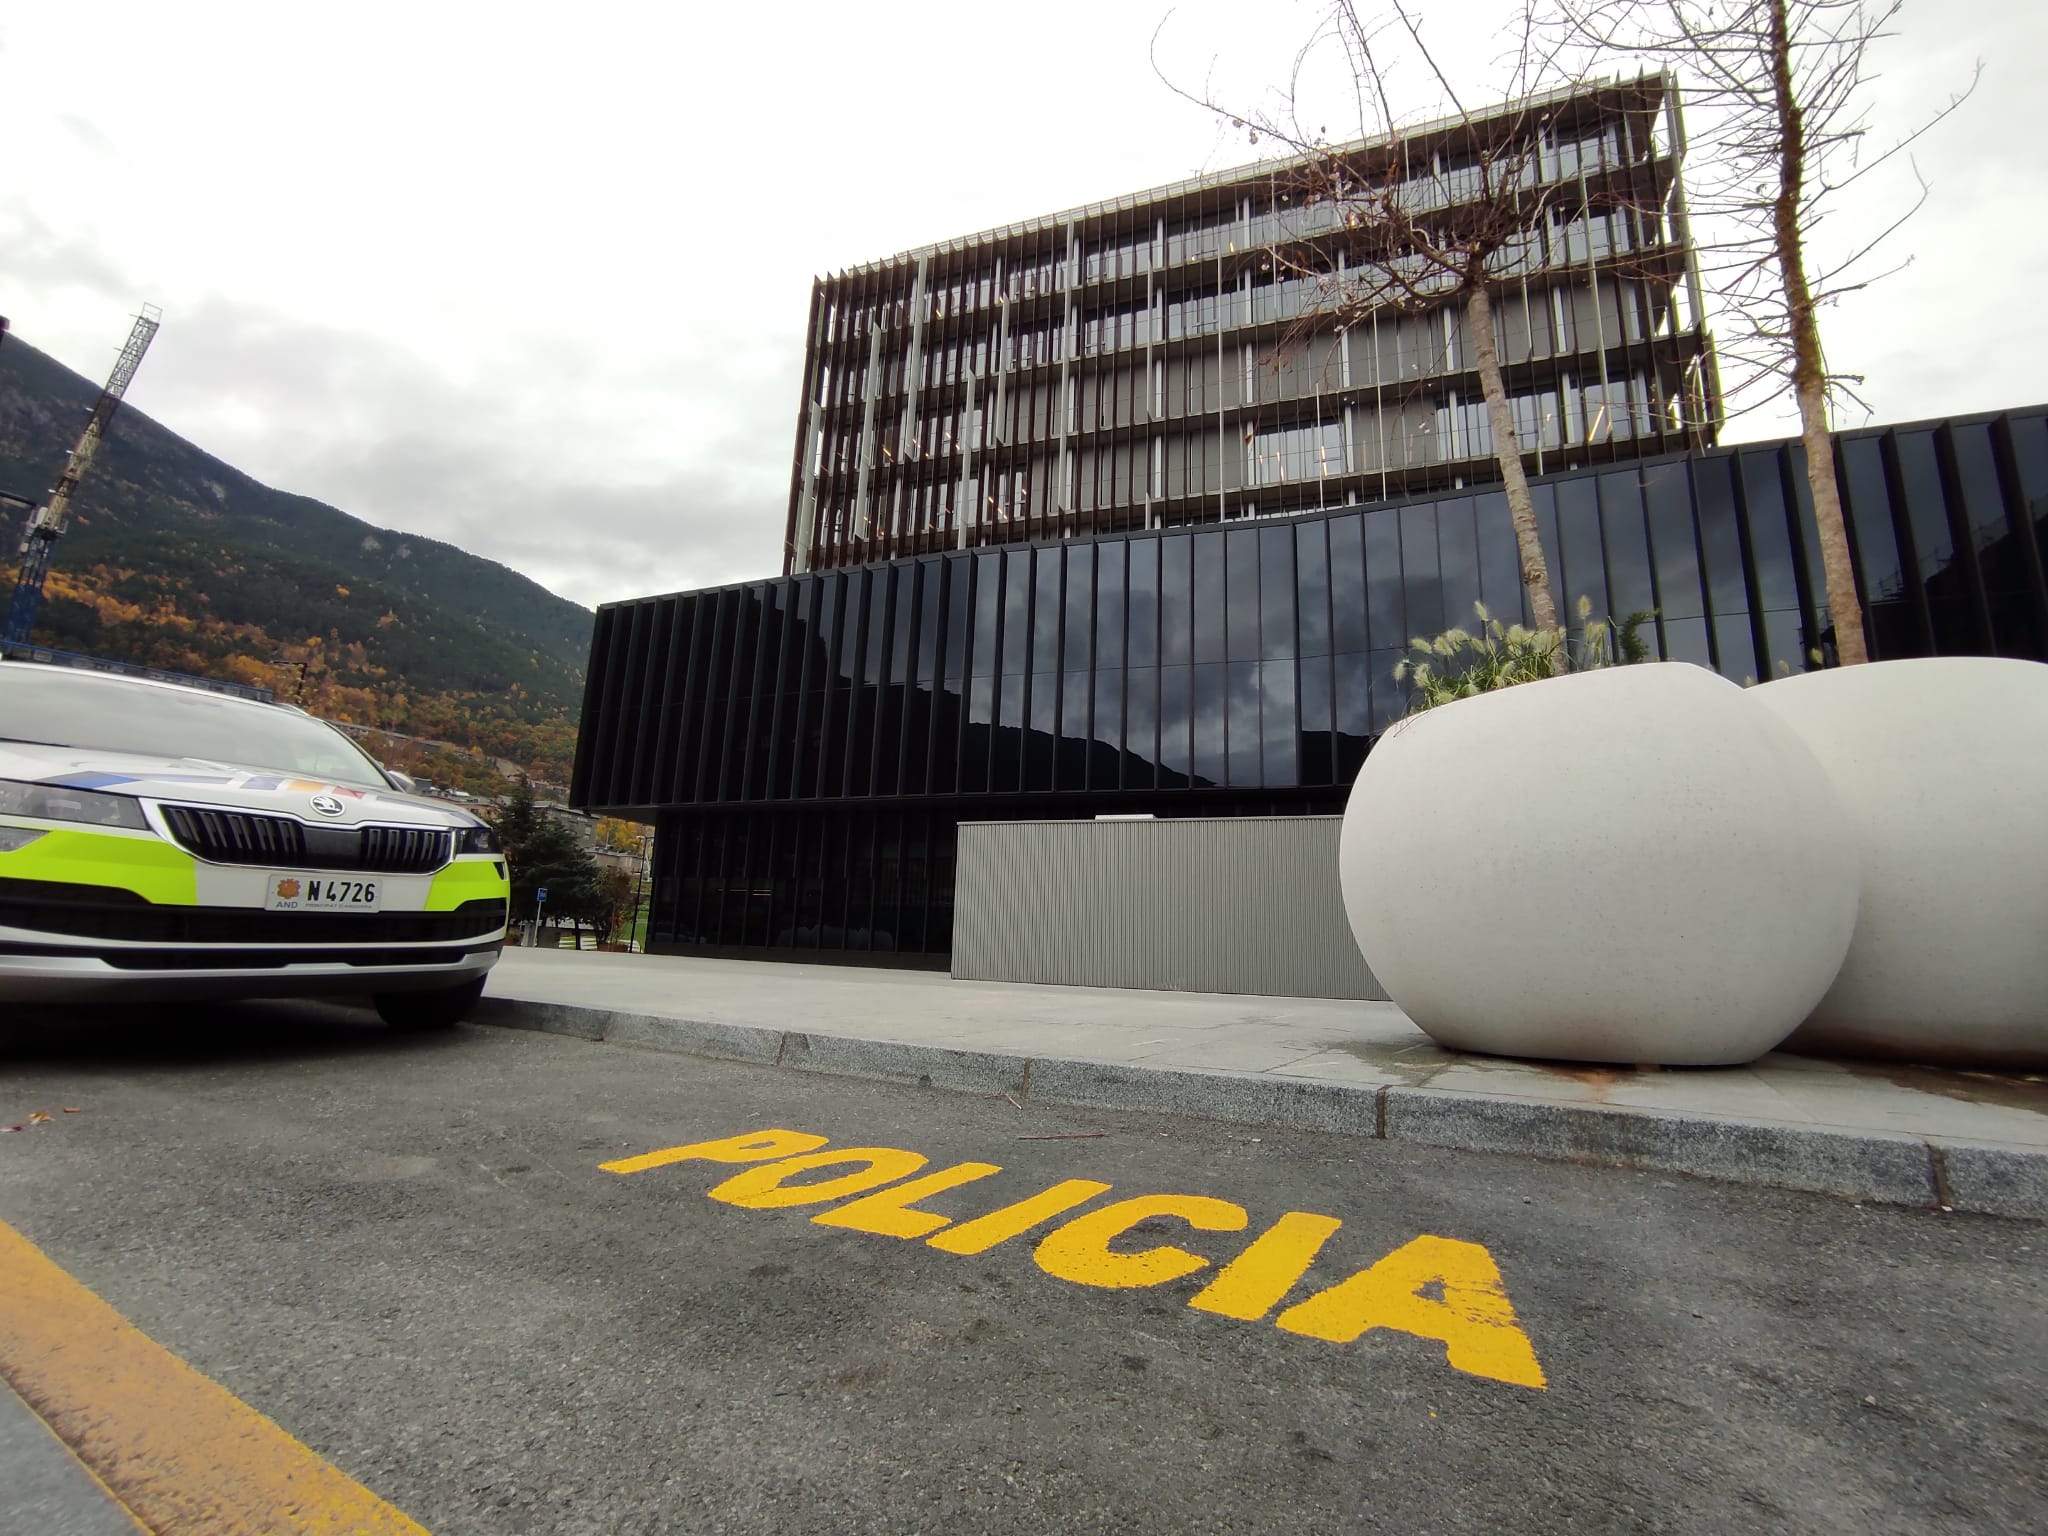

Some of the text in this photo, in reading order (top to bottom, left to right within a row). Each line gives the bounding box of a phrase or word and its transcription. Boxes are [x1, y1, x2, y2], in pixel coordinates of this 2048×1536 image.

[307, 880, 376, 903] N 4726
[276, 901, 298, 909] AND
[599, 1128, 1548, 1390] POLICIA
